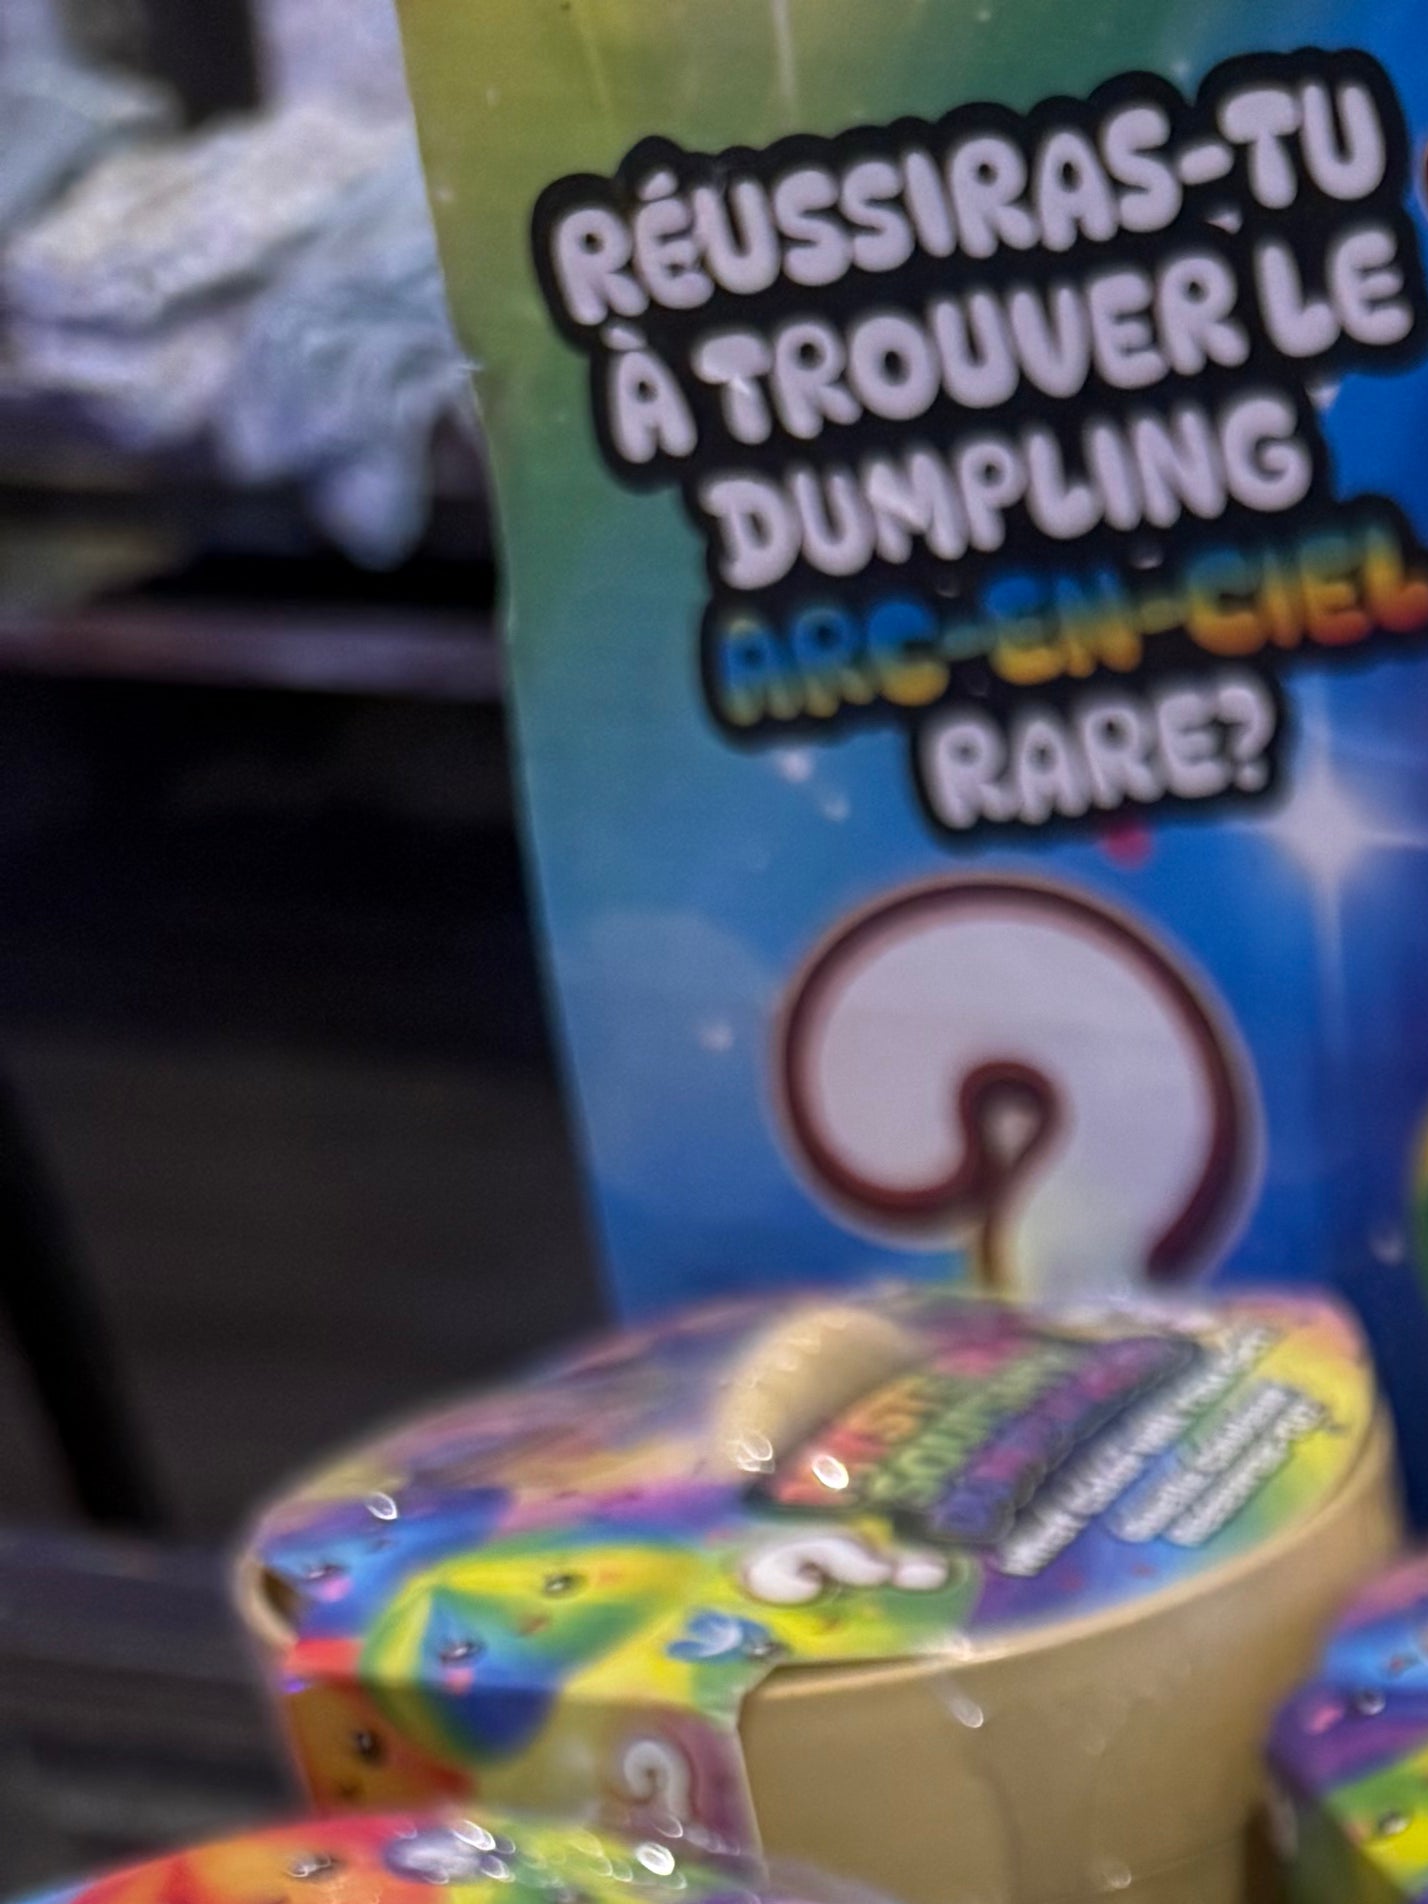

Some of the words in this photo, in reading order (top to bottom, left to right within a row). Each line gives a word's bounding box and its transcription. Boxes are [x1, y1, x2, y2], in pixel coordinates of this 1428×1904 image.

[556, 82, 1387, 328] RÉUSSIRAS-TU
[611, 326, 695, 463] À
[699, 258, 1250, 445] TROUVER
[1261, 228, 1414, 361] LE
[702, 396, 1312, 592] DUMPLING
[925, 685, 1277, 826] RARE?
